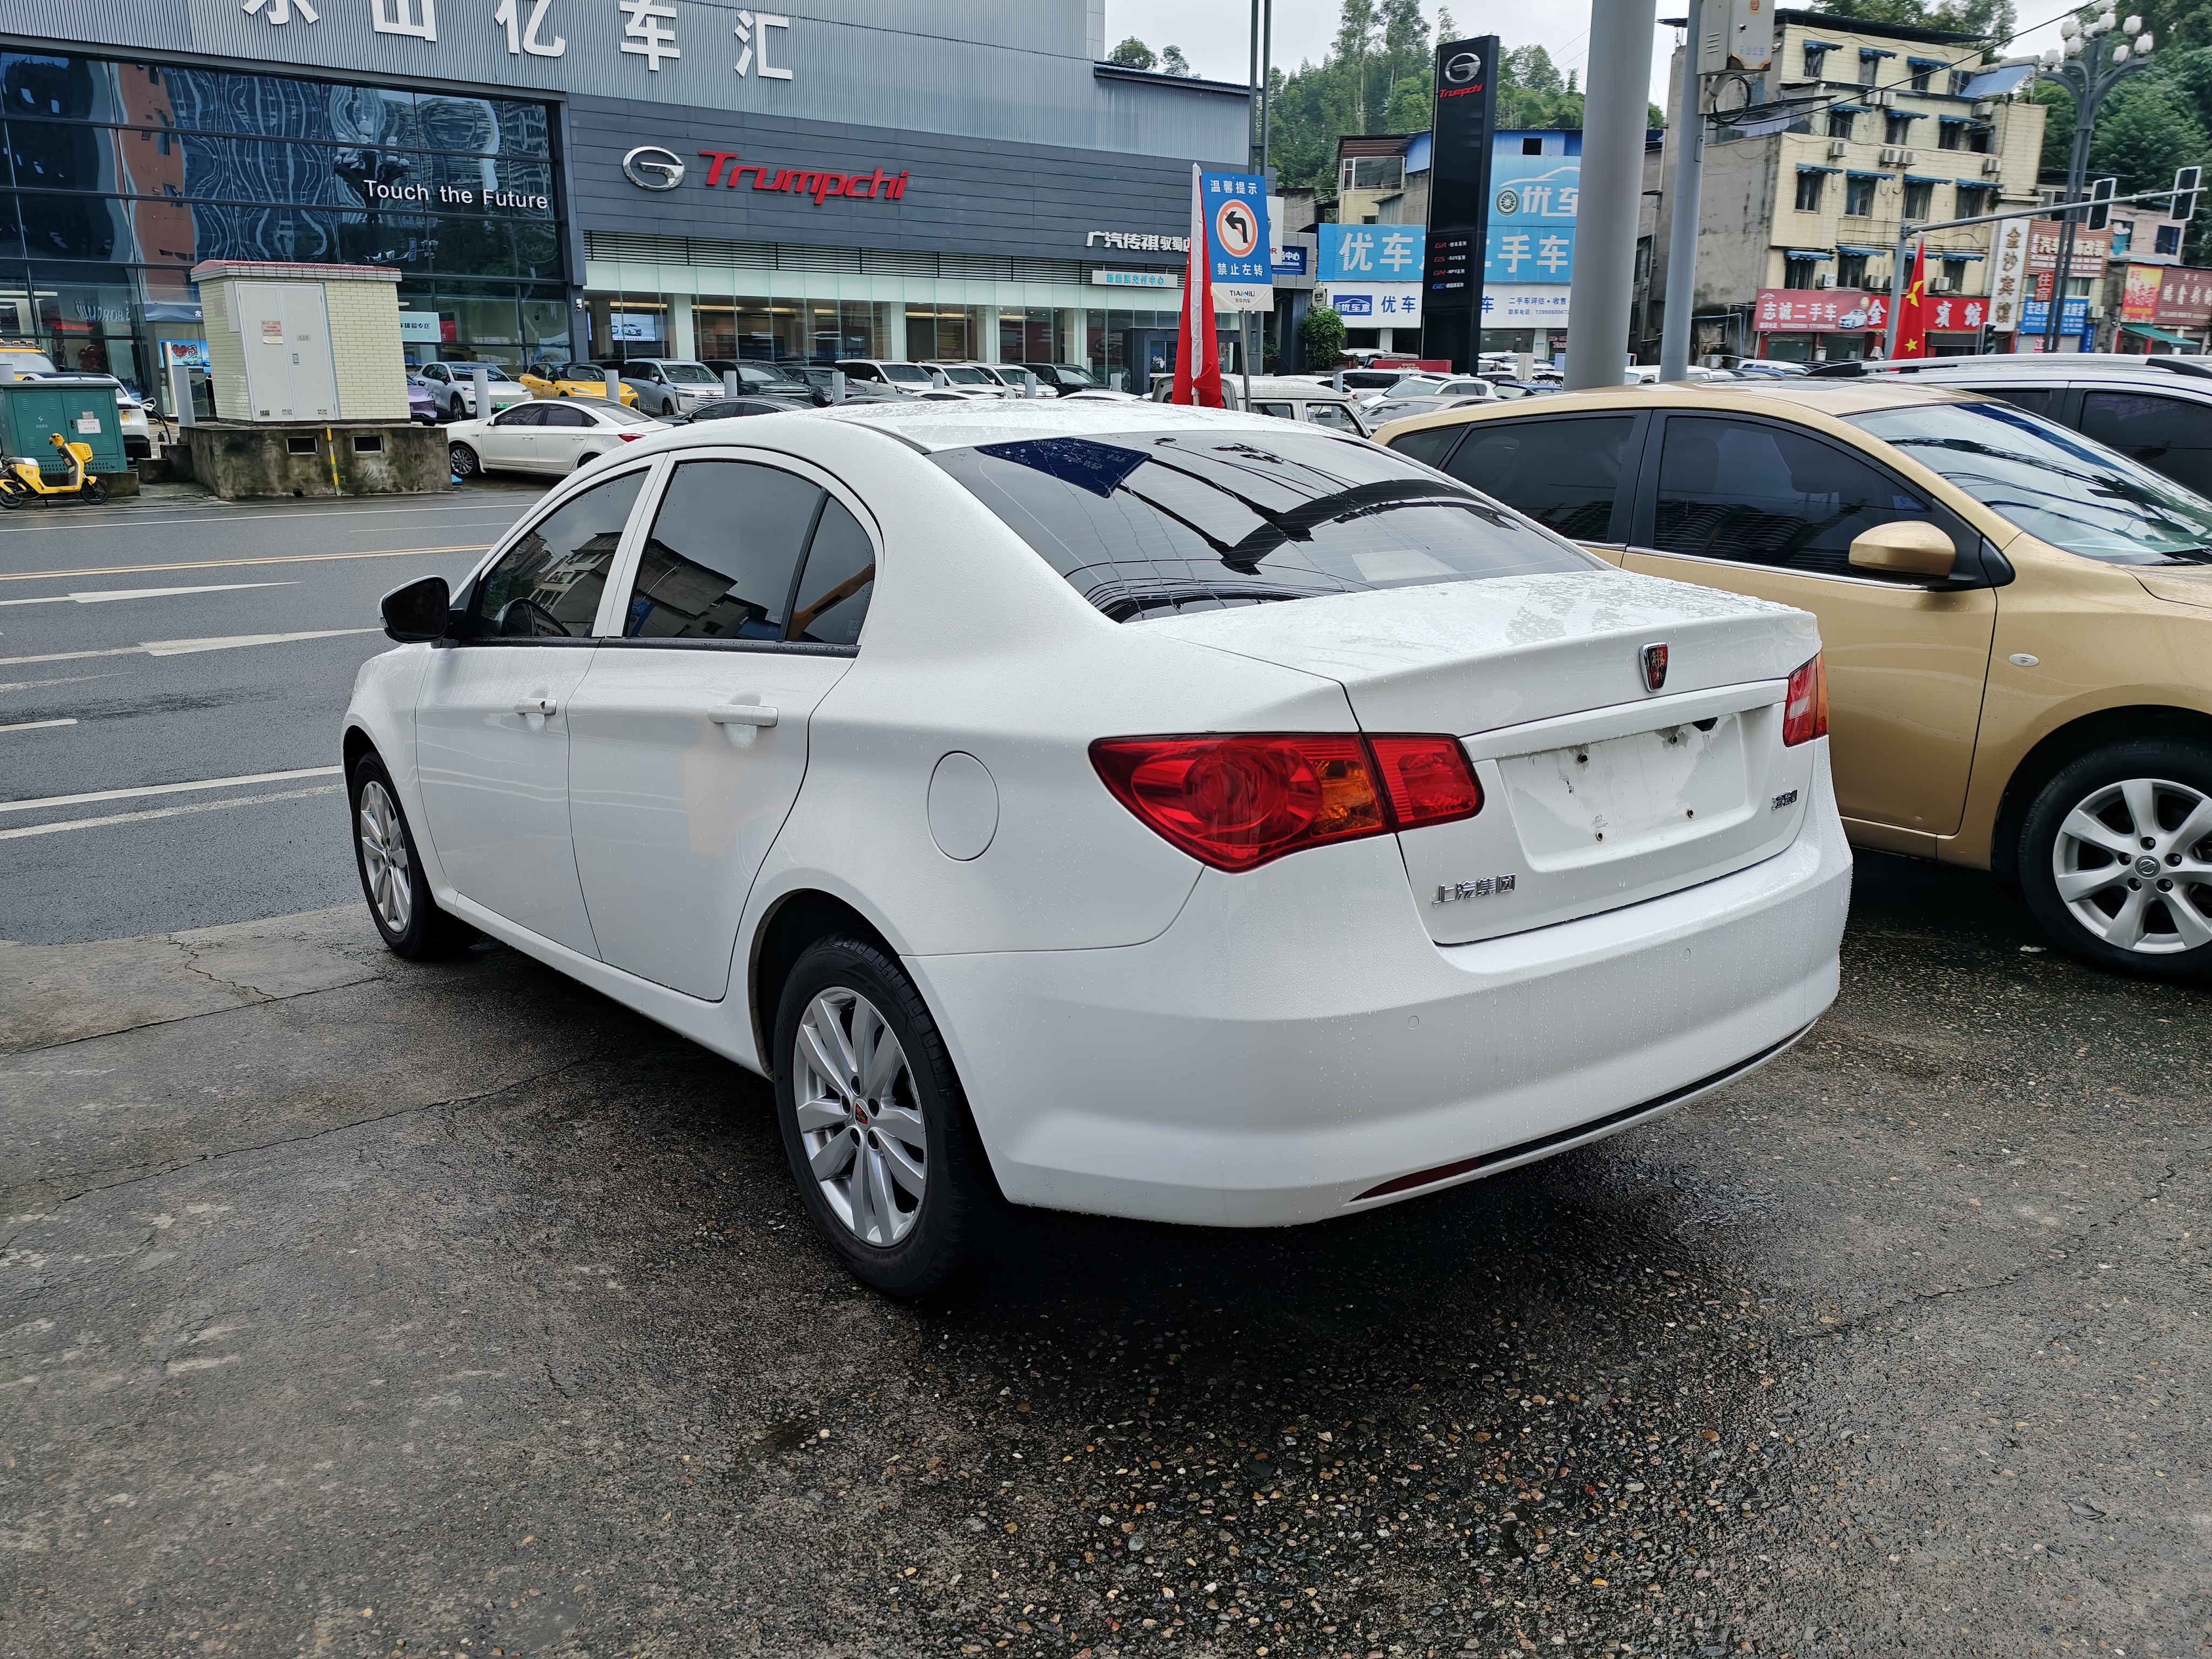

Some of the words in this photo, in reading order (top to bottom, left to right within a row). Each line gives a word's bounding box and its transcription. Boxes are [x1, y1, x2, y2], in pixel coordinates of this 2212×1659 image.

[1440, 84, 1483, 98] Trumpchi
[699, 150, 910, 205] Trumpchi
[363, 179, 429, 201] Touch
[440, 185, 473, 204] the
[483, 189, 548, 209] Future
[1210, 179, 1258, 195] 温馨提示
[1217, 262, 1263, 276] 禁止左转
[1107, 273, 1164, 285] 新能源交付中心
[1341, 304, 1371, 313] 优车惠
[1762, 301, 1838, 322] 志诚二手车
[1432, 873, 1517, 905] 上汽集团
